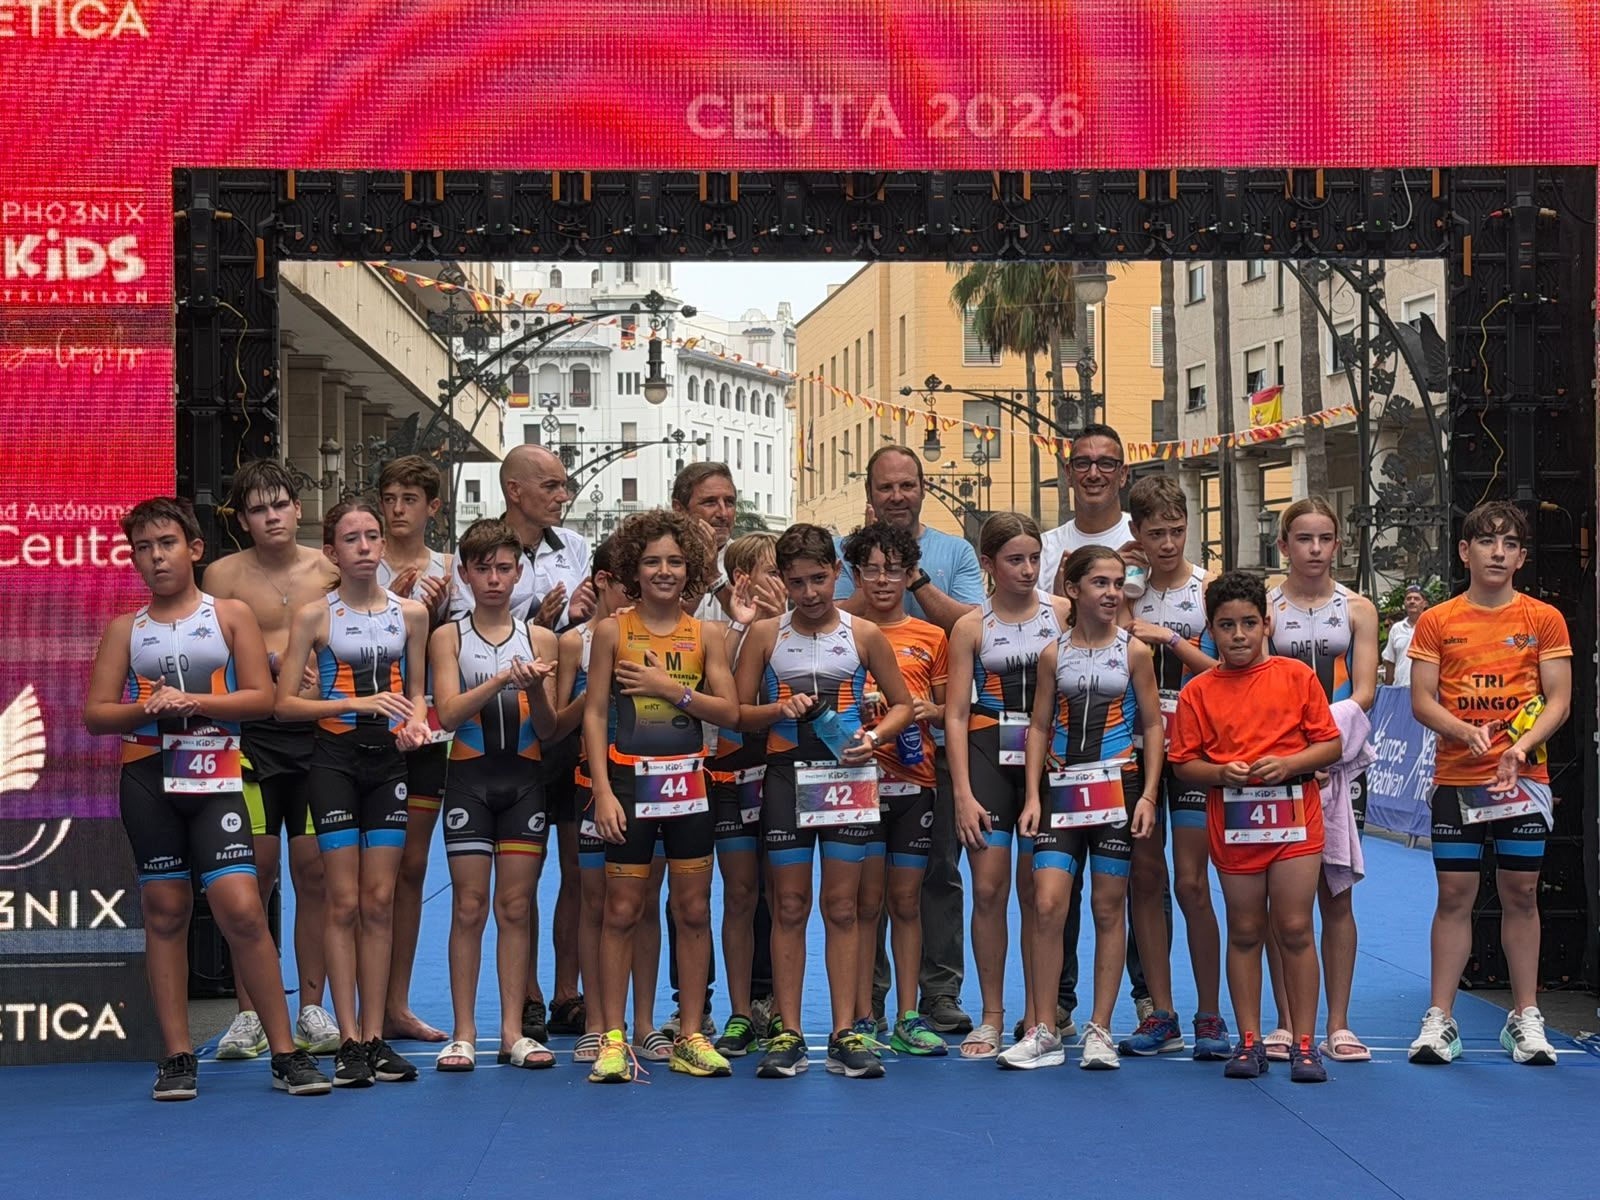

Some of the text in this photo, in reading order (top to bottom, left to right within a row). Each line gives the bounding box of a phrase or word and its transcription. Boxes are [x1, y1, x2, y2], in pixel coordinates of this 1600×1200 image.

[686, 93, 1084, 139] CEUTA 2026
[2, 200, 145, 225] PHO3NIX
[3, 291, 148, 303] TRIATHLON
[1291, 639, 1329, 658] DAFNE
[158, 653, 190, 675] LEO
[1472, 674, 1504, 688] TRI
[1457, 696, 1521, 711] DINGO
[188, 753, 217, 775] 46
[660, 776, 689, 798] 44
[824, 785, 854, 807] 42
[1079, 787, 1091, 807] 1
[1250, 804, 1278, 825] 41
[216, 849, 254, 860] BALEARIA
[0, 1002, 127, 1041] TICA
